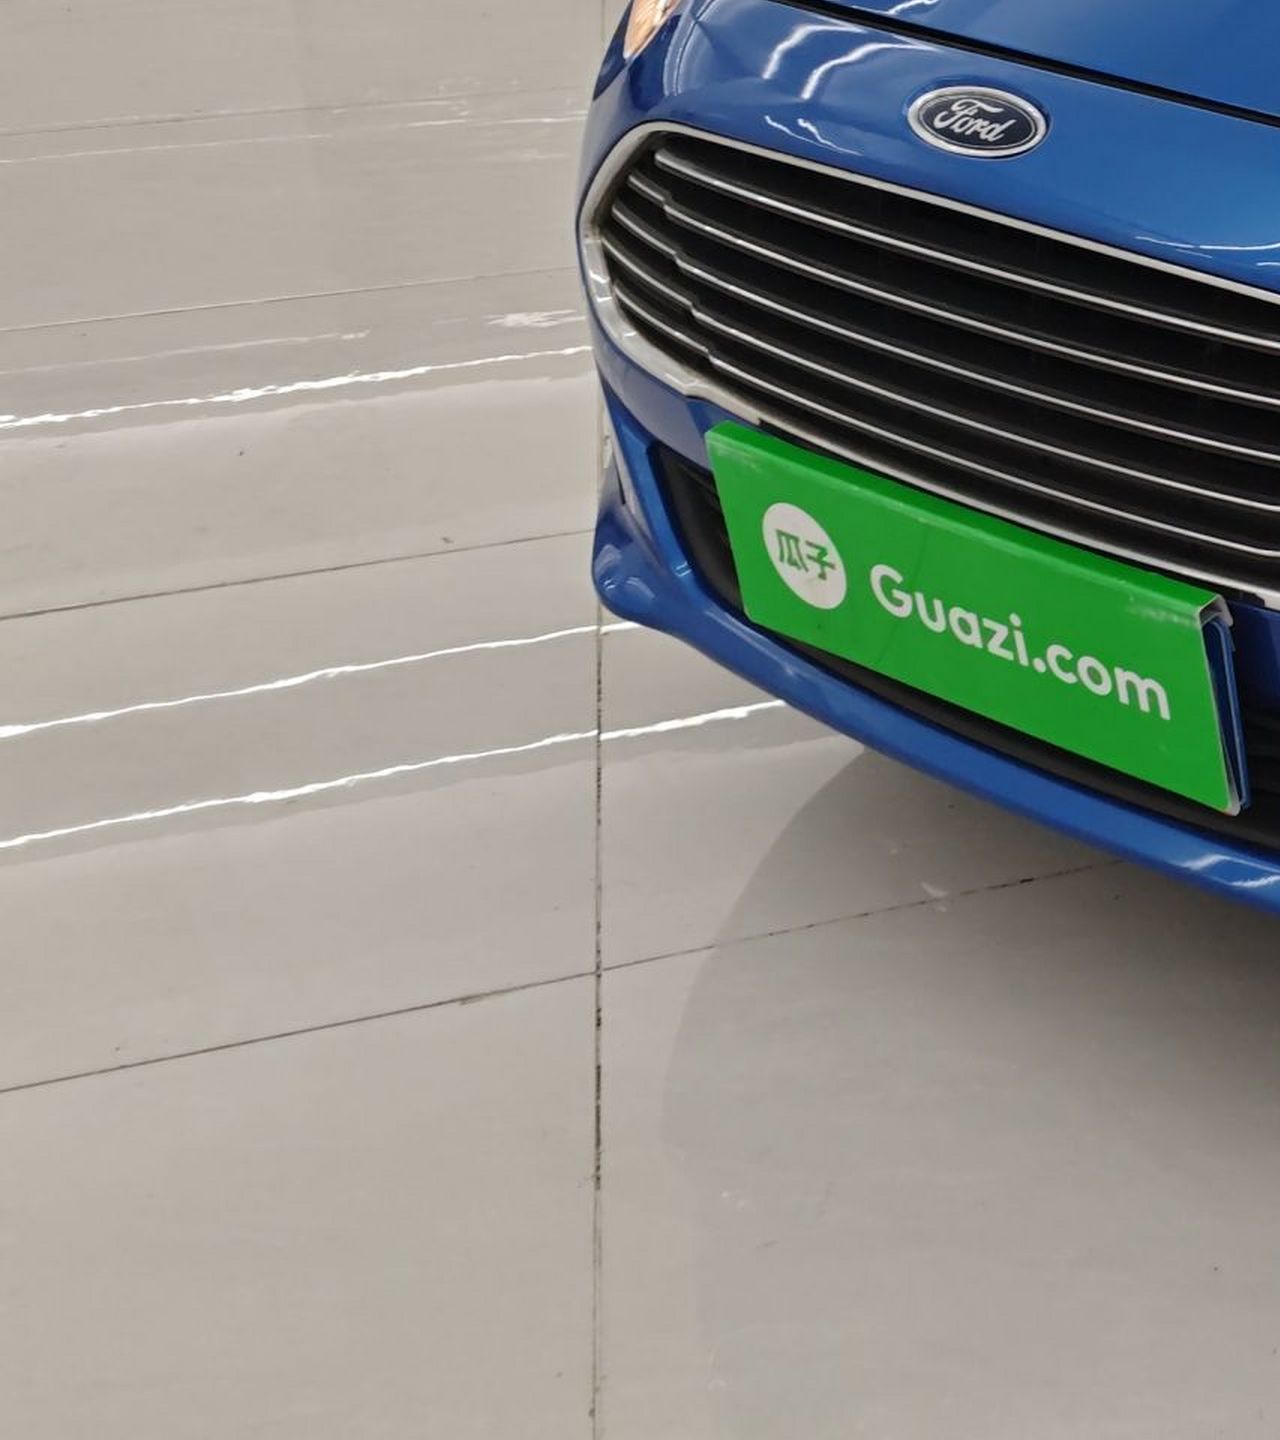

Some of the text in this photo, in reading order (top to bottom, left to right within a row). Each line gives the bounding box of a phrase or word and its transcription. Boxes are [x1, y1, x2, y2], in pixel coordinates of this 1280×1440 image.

[933, 98, 1017, 143] Ford
[774, 527, 837, 581] 瓜子
[870, 563, 1172, 722] Guazi.com
